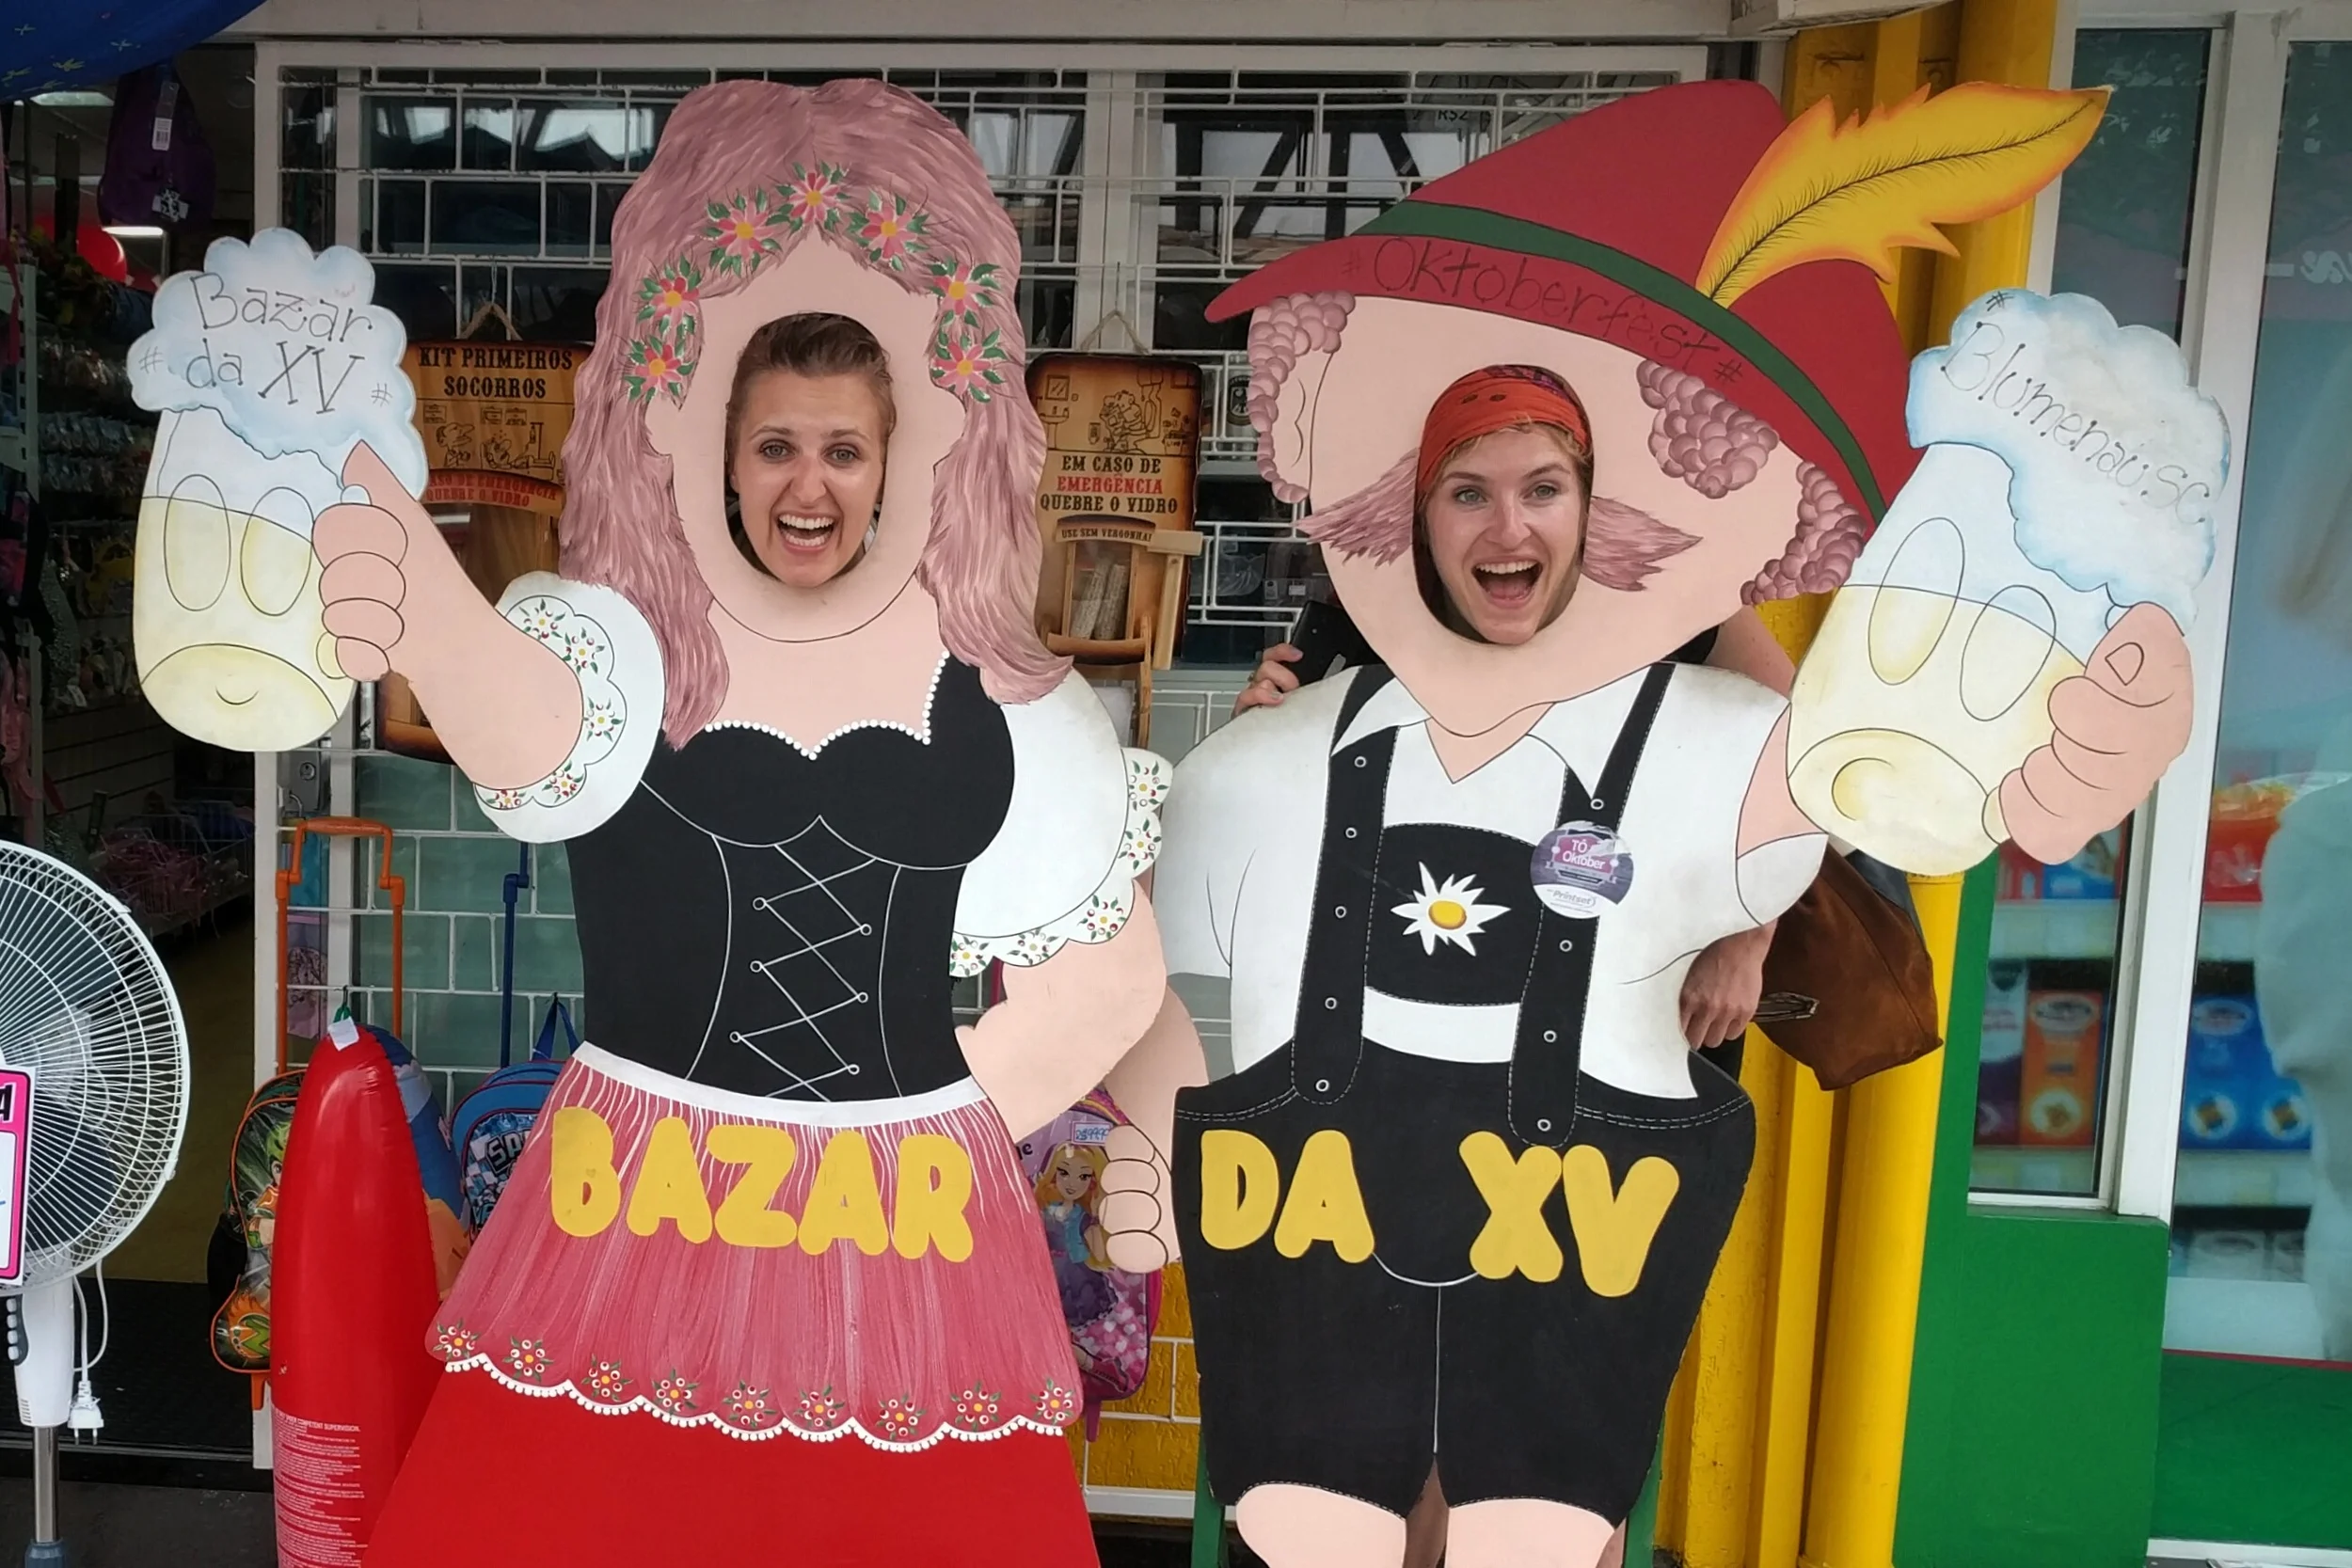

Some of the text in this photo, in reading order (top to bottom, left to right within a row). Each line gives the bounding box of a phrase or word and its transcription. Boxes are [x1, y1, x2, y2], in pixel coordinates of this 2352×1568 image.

[190, 273, 373, 341] Bazar
[419, 346, 572, 370] KIT PRIMEIROS
[186, 338, 243, 388] da
[258, 341, 364, 414] XV
[444, 375, 546, 399] SOCORROS
[1062, 456, 1161, 473] EM CASO DE
[1057, 472, 1163, 494] EMERGÊNCIA
[426, 488, 530, 506] QUEBRE O VIDRO
[1041, 494, 1178, 513] QUEBRE O VIDRO
[1061, 529, 1077, 538] USE
[1080, 528, 1098, 537] SEM
[551, 1106, 974, 1262] BAZAR
[1200, 1130, 1680, 1298] DA XV
